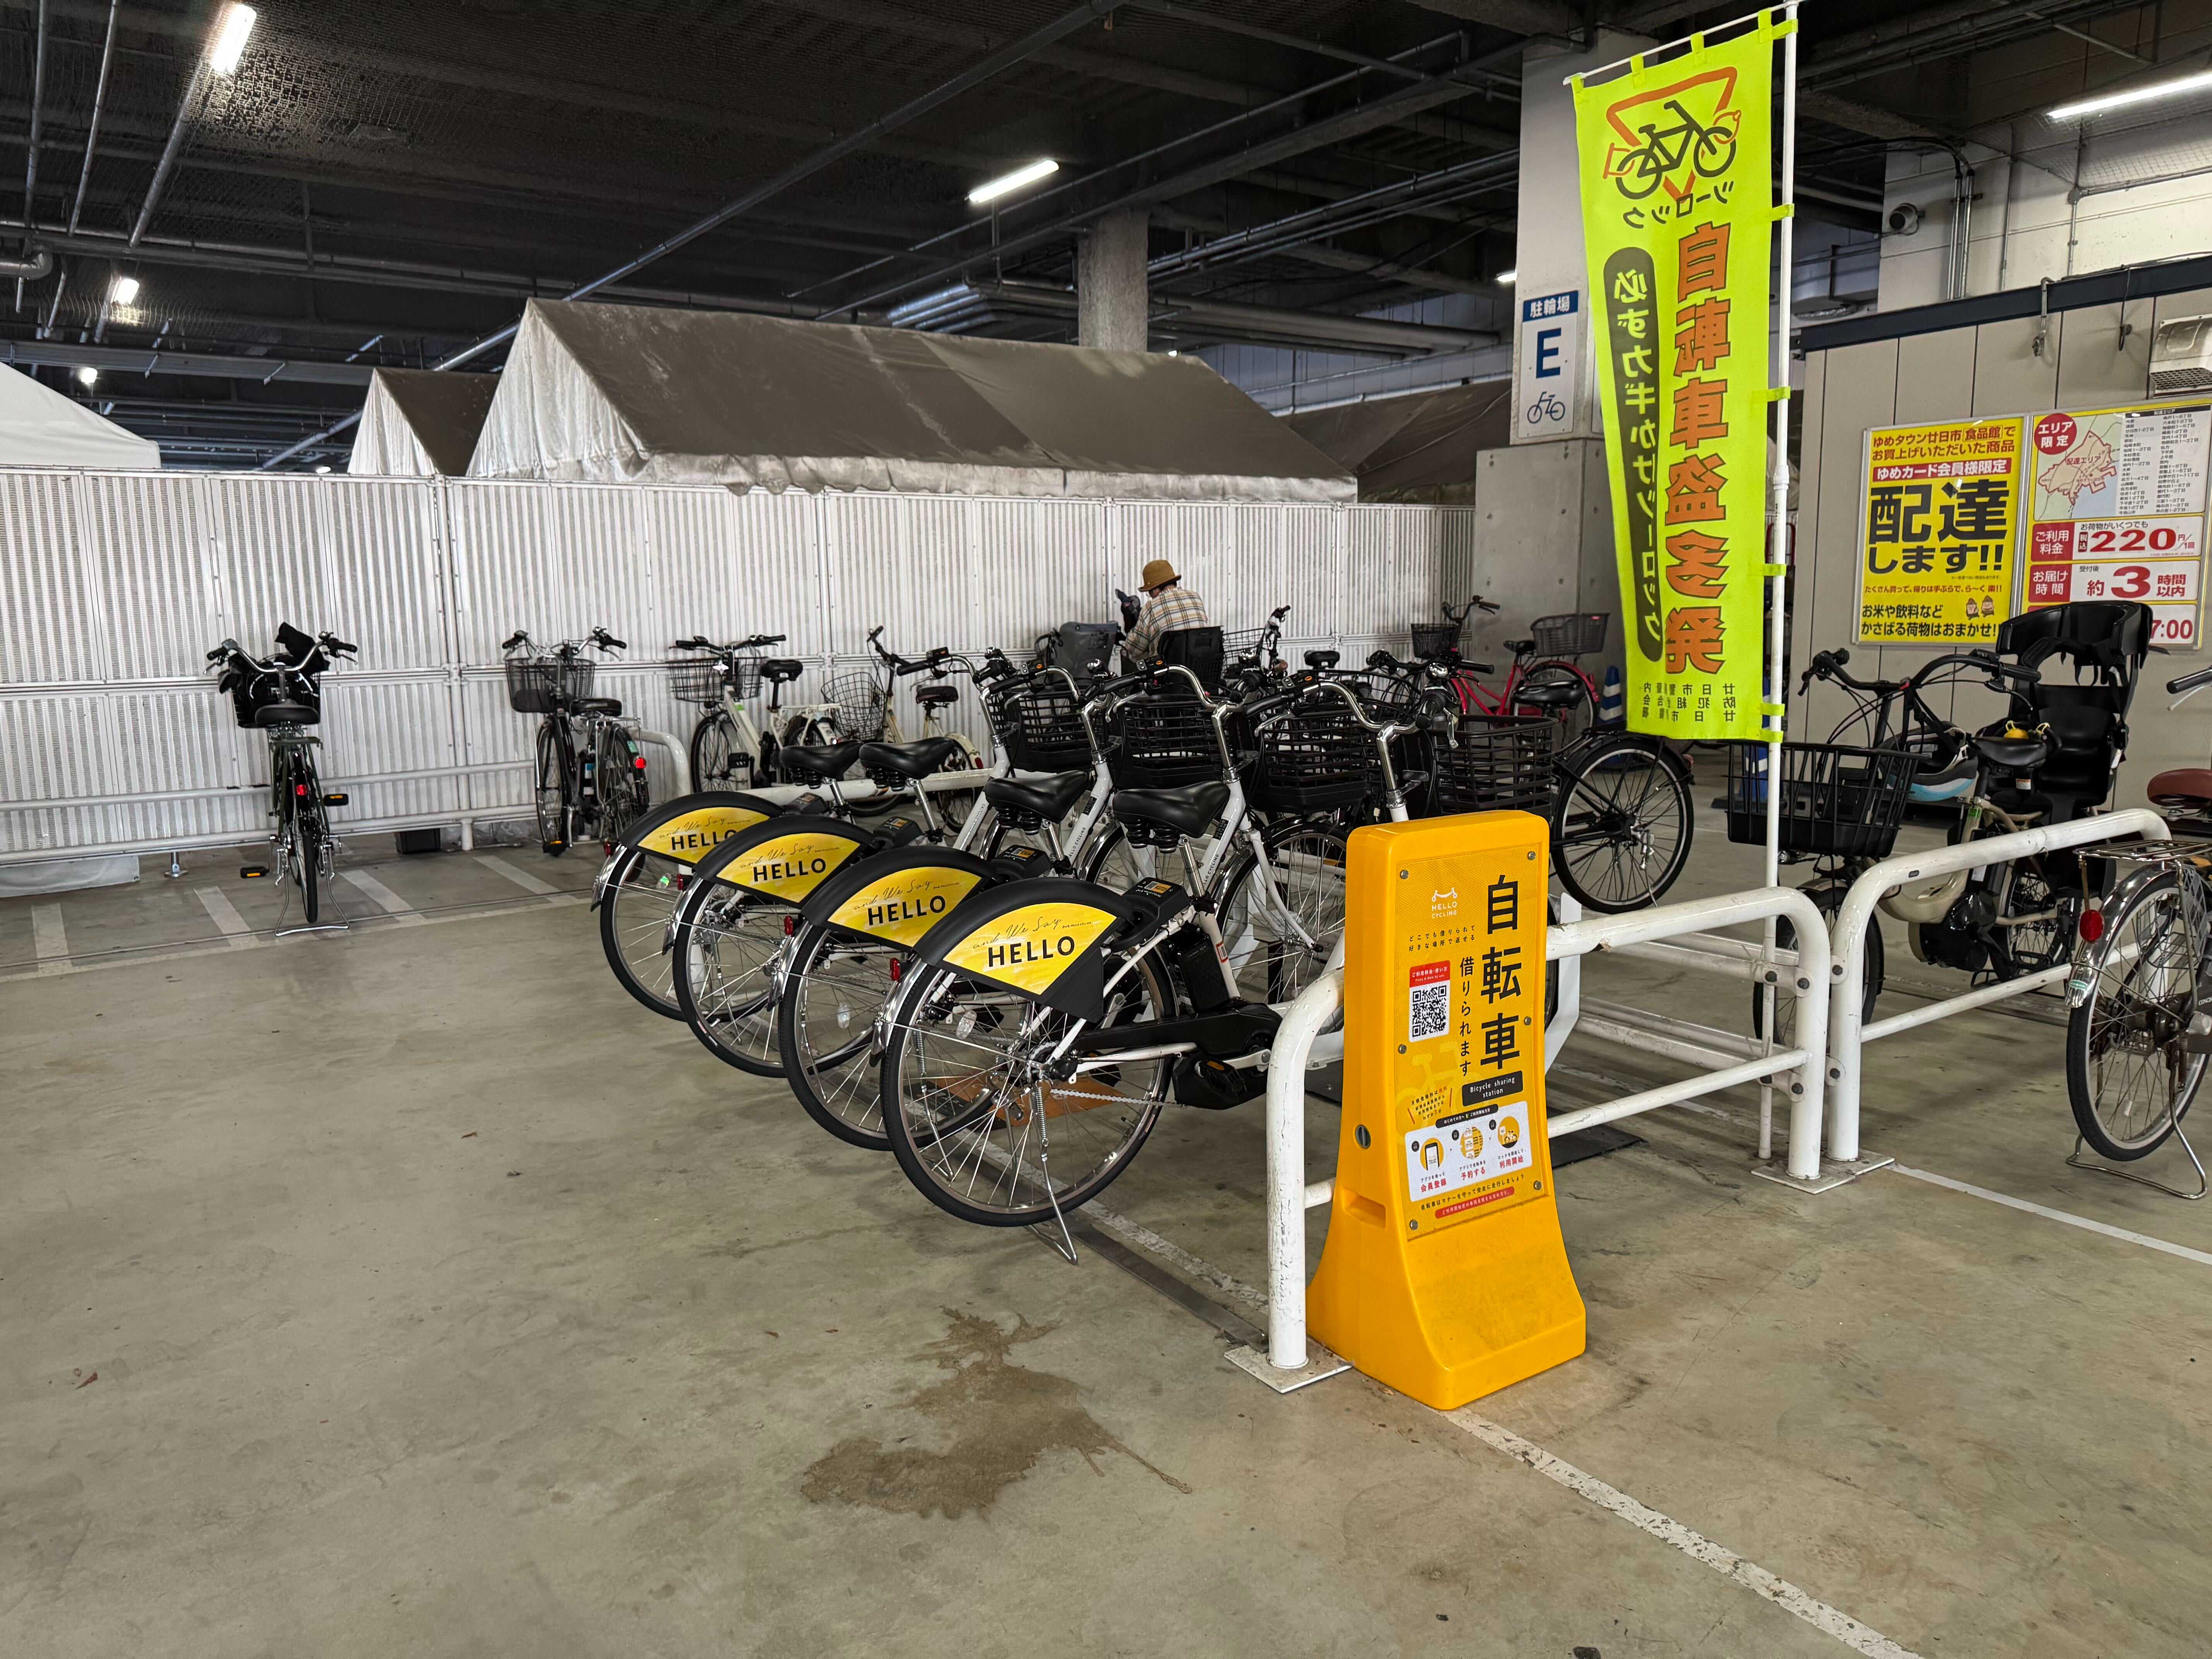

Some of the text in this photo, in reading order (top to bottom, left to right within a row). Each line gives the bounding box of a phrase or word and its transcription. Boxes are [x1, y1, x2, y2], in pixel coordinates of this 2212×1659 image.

[1530, 295, 1570, 318] 駐輪場
[1536, 328, 1561, 379] E
[2038, 421, 2073, 434] エリア
[2041, 435, 2069, 449] 限定
[1872, 440, 2015, 461] お買上げいただいた商品
[2066, 456, 2101, 465] 配達エリア
[1877, 459, 2007, 481] ゆめカード会員様限定
[1869, 479, 2010, 544] 配達
[2080, 521, 2148, 531] お荷物がいくつでも
[2036, 531, 2069, 542] ご利用
[2090, 529, 2176, 552] 220
[2040, 543, 2064, 555] 料金
[2033, 570, 2068, 582] お届け
[2087, 565, 2186, 599] 約 3 時間
[2035, 584, 2064, 595] 時間
[2157, 586, 2185, 597] 以内
[1862, 604, 1943, 619] お米や飲料など
[684, 821, 701, 833] We
[706, 816, 727, 826] Say
[740, 856, 762, 869] and
[767, 848, 787, 862] We
[790, 843, 814, 855] Say
[1208, 854, 1219, 874] CYCLING
[753, 858, 827, 882] HELLO
[854, 895, 877, 911] and
[883, 885, 903, 901] We
[907, 879, 933, 893] Say
[868, 895, 946, 926] HELLO
[1432, 901, 1457, 911] HELLO
[1432, 910, 1457, 919] CYCLING
[973, 933, 1000, 949] and
[1006, 923, 1029, 939] We
[1033, 916, 1062, 932] Say
[1410, 925, 1475, 941] どこでも借りられて
[1409, 934, 1474, 951] 好きな場所で返せる
[988, 936, 1075, 967] HELLO
[1480, 874, 1521, 1070] 自転車
[1460, 957, 1474, 1077] 借りられます
[1470, 1077, 1515, 1093] Bicycle sharing
[1483, 1088, 1503, 1098] station
[1499, 1156, 1524, 1170] 利用開始
[1461, 1166, 1486, 1181] 予約する
[1420, 1178, 1447, 1192] 会員登録
